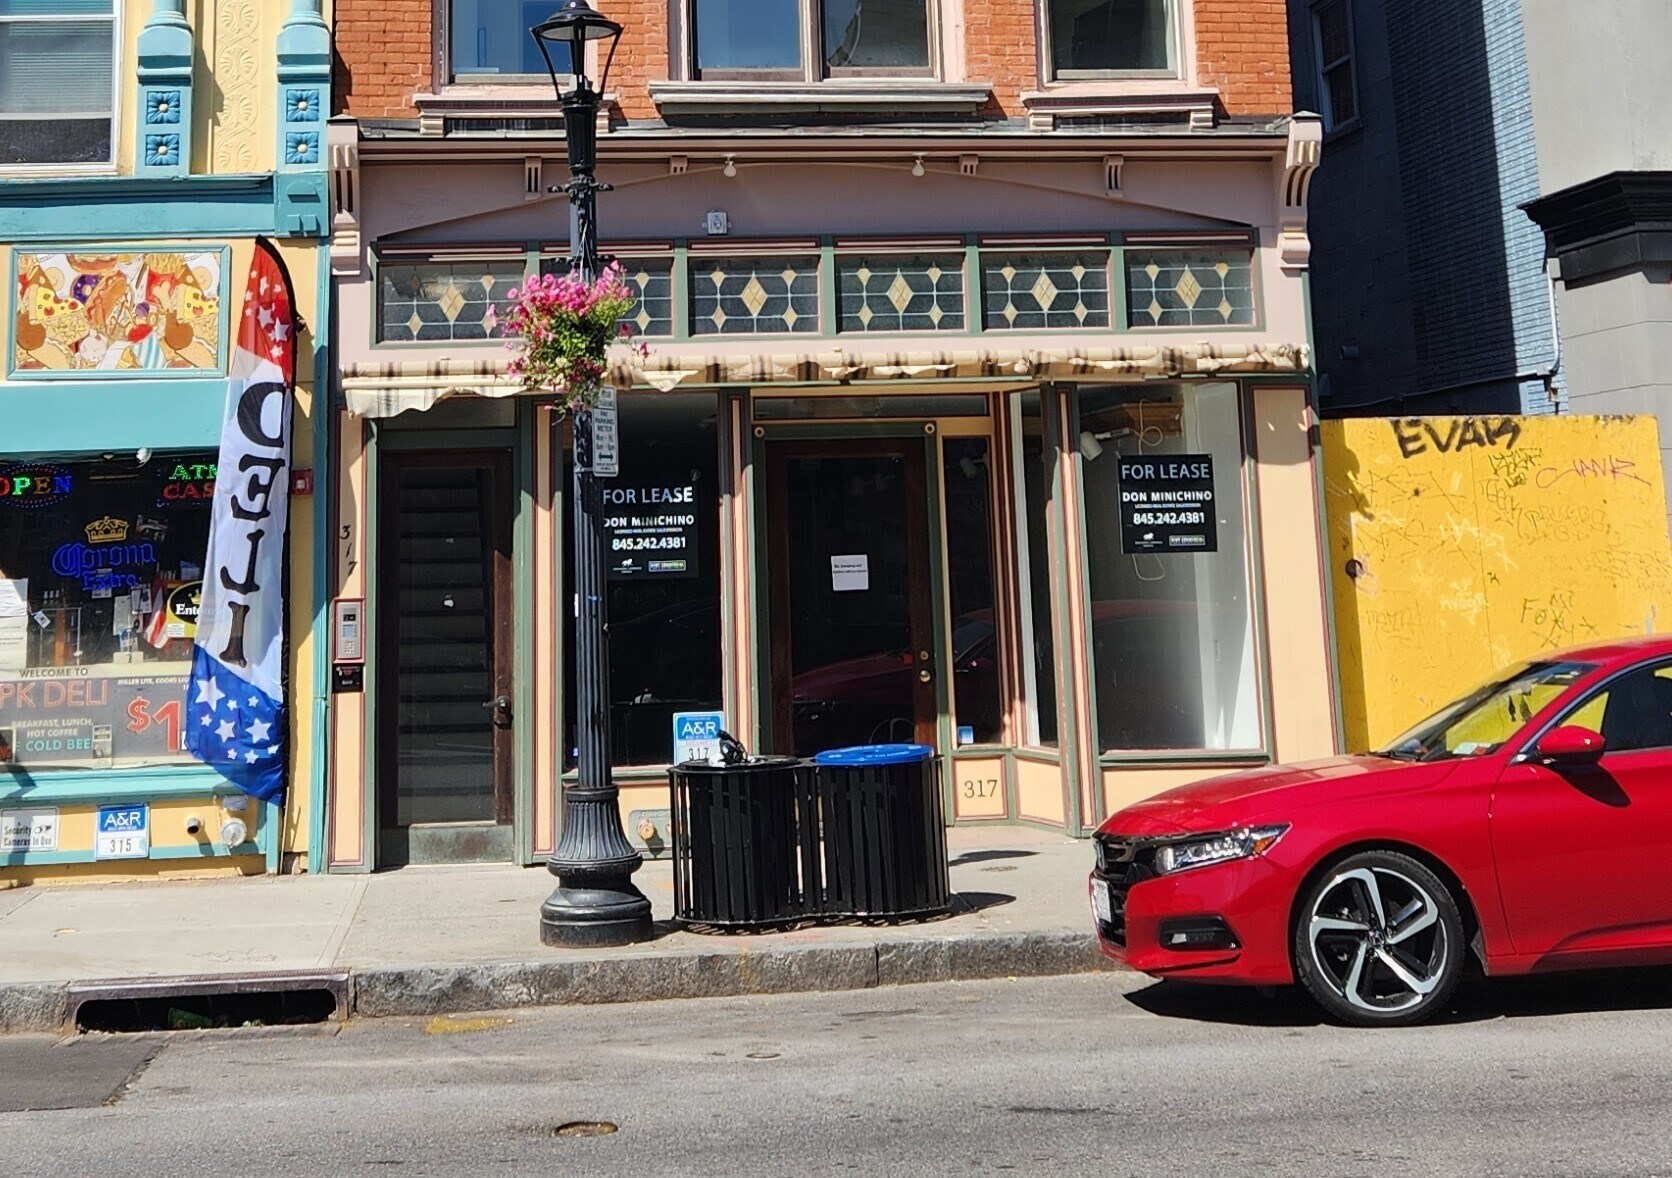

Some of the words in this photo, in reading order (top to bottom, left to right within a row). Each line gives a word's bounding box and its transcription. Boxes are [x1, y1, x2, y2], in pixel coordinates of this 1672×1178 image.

[1121, 464, 1155, 480] FOR
[1160, 463, 1210, 479] LEASE
[603, 488, 637, 505] FOR
[641, 486, 694, 503] LEASE
[1122, 491, 1148, 502] DON
[1151, 490, 1213, 502] MINICHINO
[631, 514, 695, 527] MINICHINO
[1133, 511, 1205, 526] 845.242.4381
[611, 536, 687, 551] 845.242.4381
[52, 542, 157, 578] Corona
[82, 570, 140, 591] Extra
[20, 667, 71, 679] WELCOME
[74, 666, 89, 677] TO
[43, 679, 108, 708] DELI
[27, 729, 46, 738] HOT
[47, 728, 78, 737] COFFEE
[681, 721, 717, 737] A&R
[25, 740, 62, 752] COLD
[66, 738, 92, 750] BEE
[964, 779, 998, 799] 317
[104, 811, 141, 828] A&R
[4, 826, 31, 836] Security
[110, 838, 132, 853] 315
